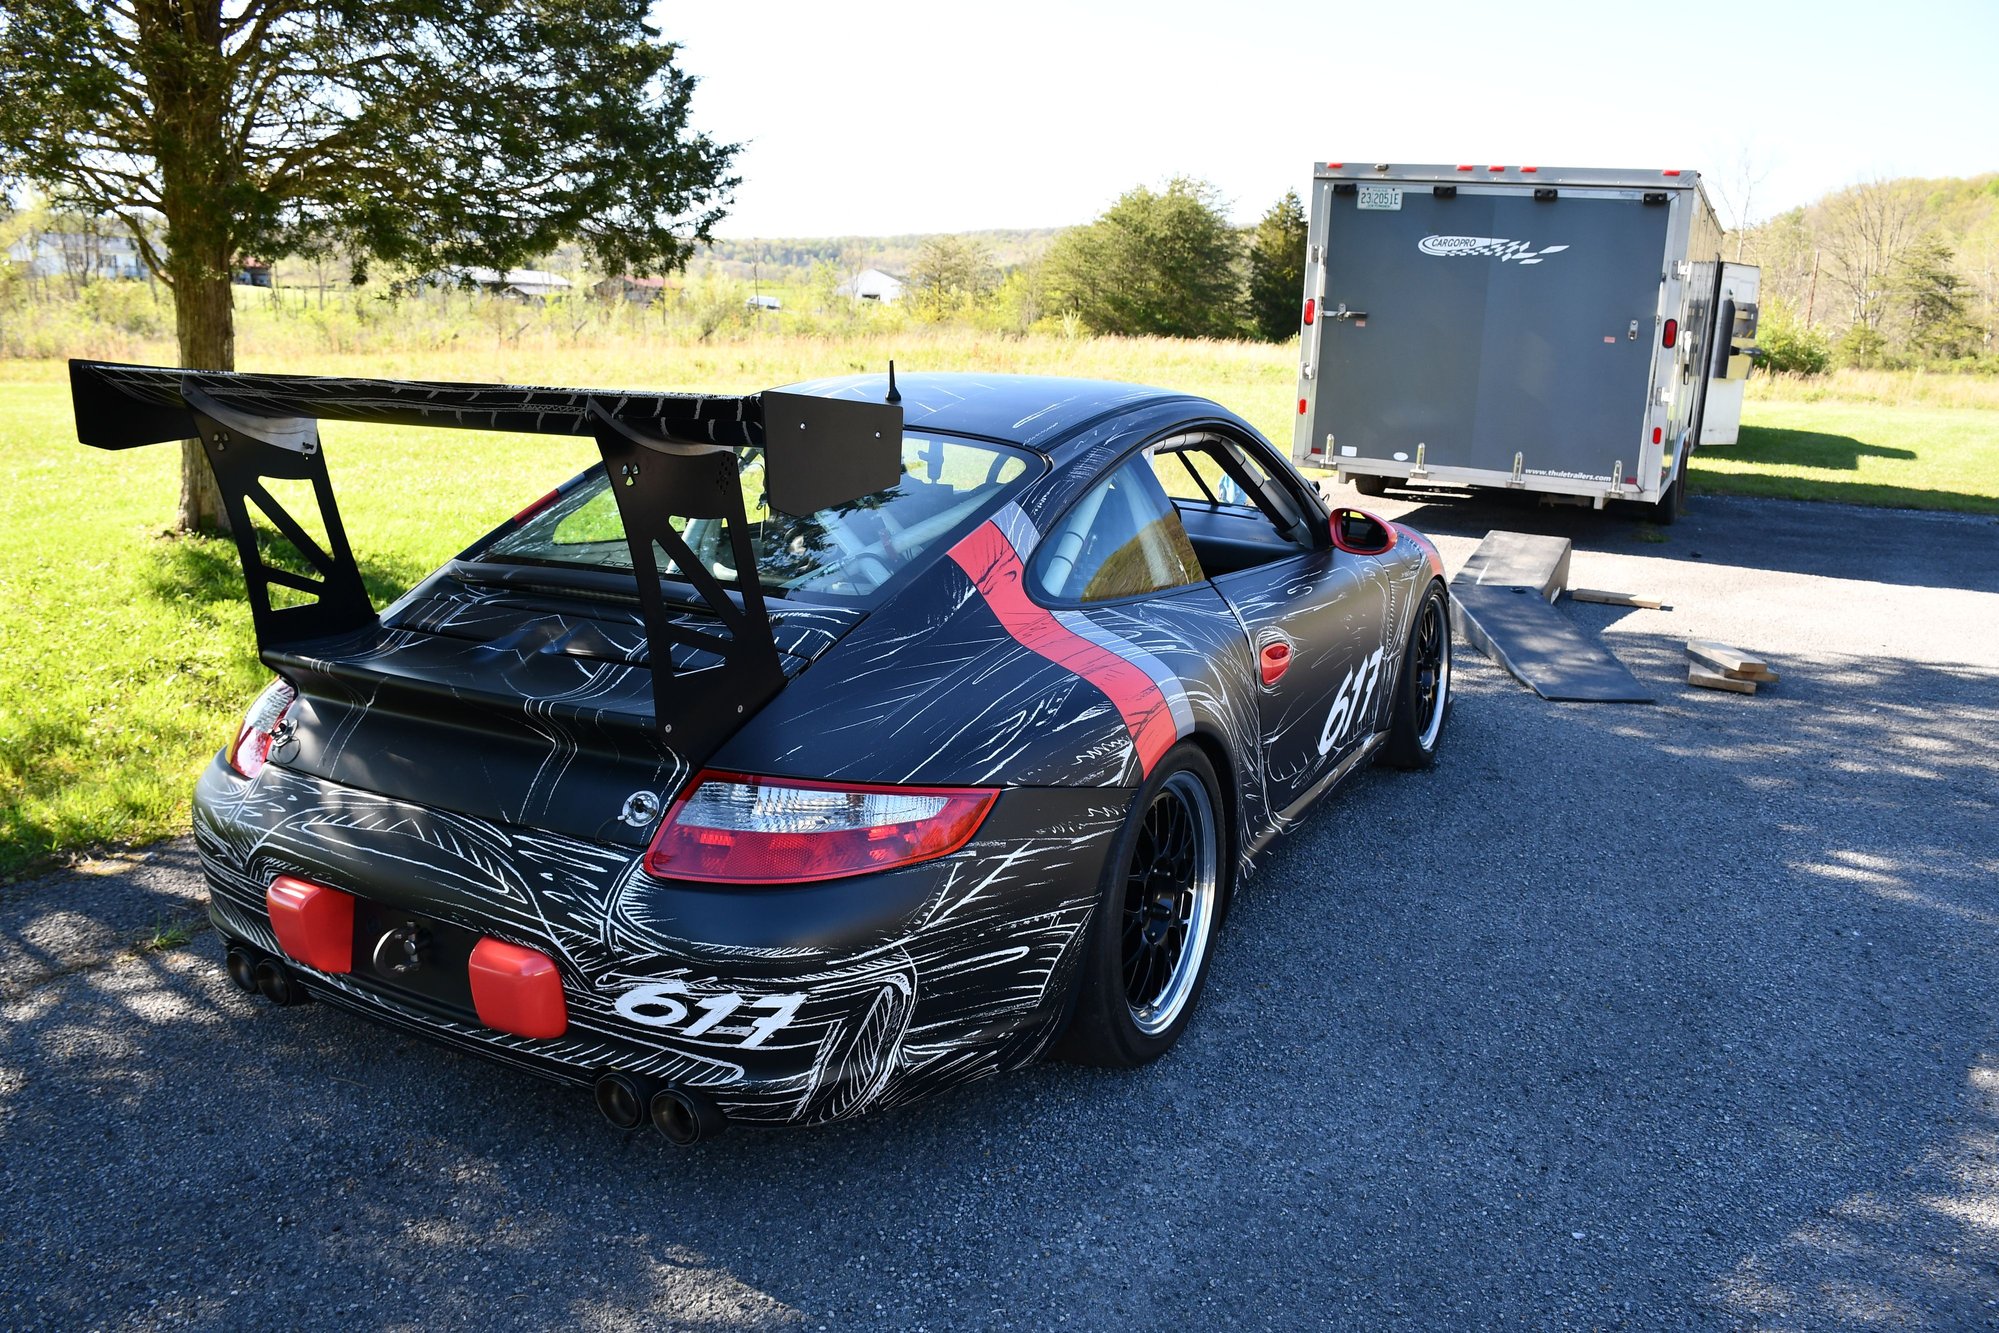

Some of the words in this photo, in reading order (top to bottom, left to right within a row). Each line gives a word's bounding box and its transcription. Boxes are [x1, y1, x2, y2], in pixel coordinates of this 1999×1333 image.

[1431, 238, 1477, 248] CARGOPRO
[1525, 468, 1612, 482] www.thuletrailers.com
[1319, 646, 1384, 756] 617
[614, 982, 809, 1048] 617
